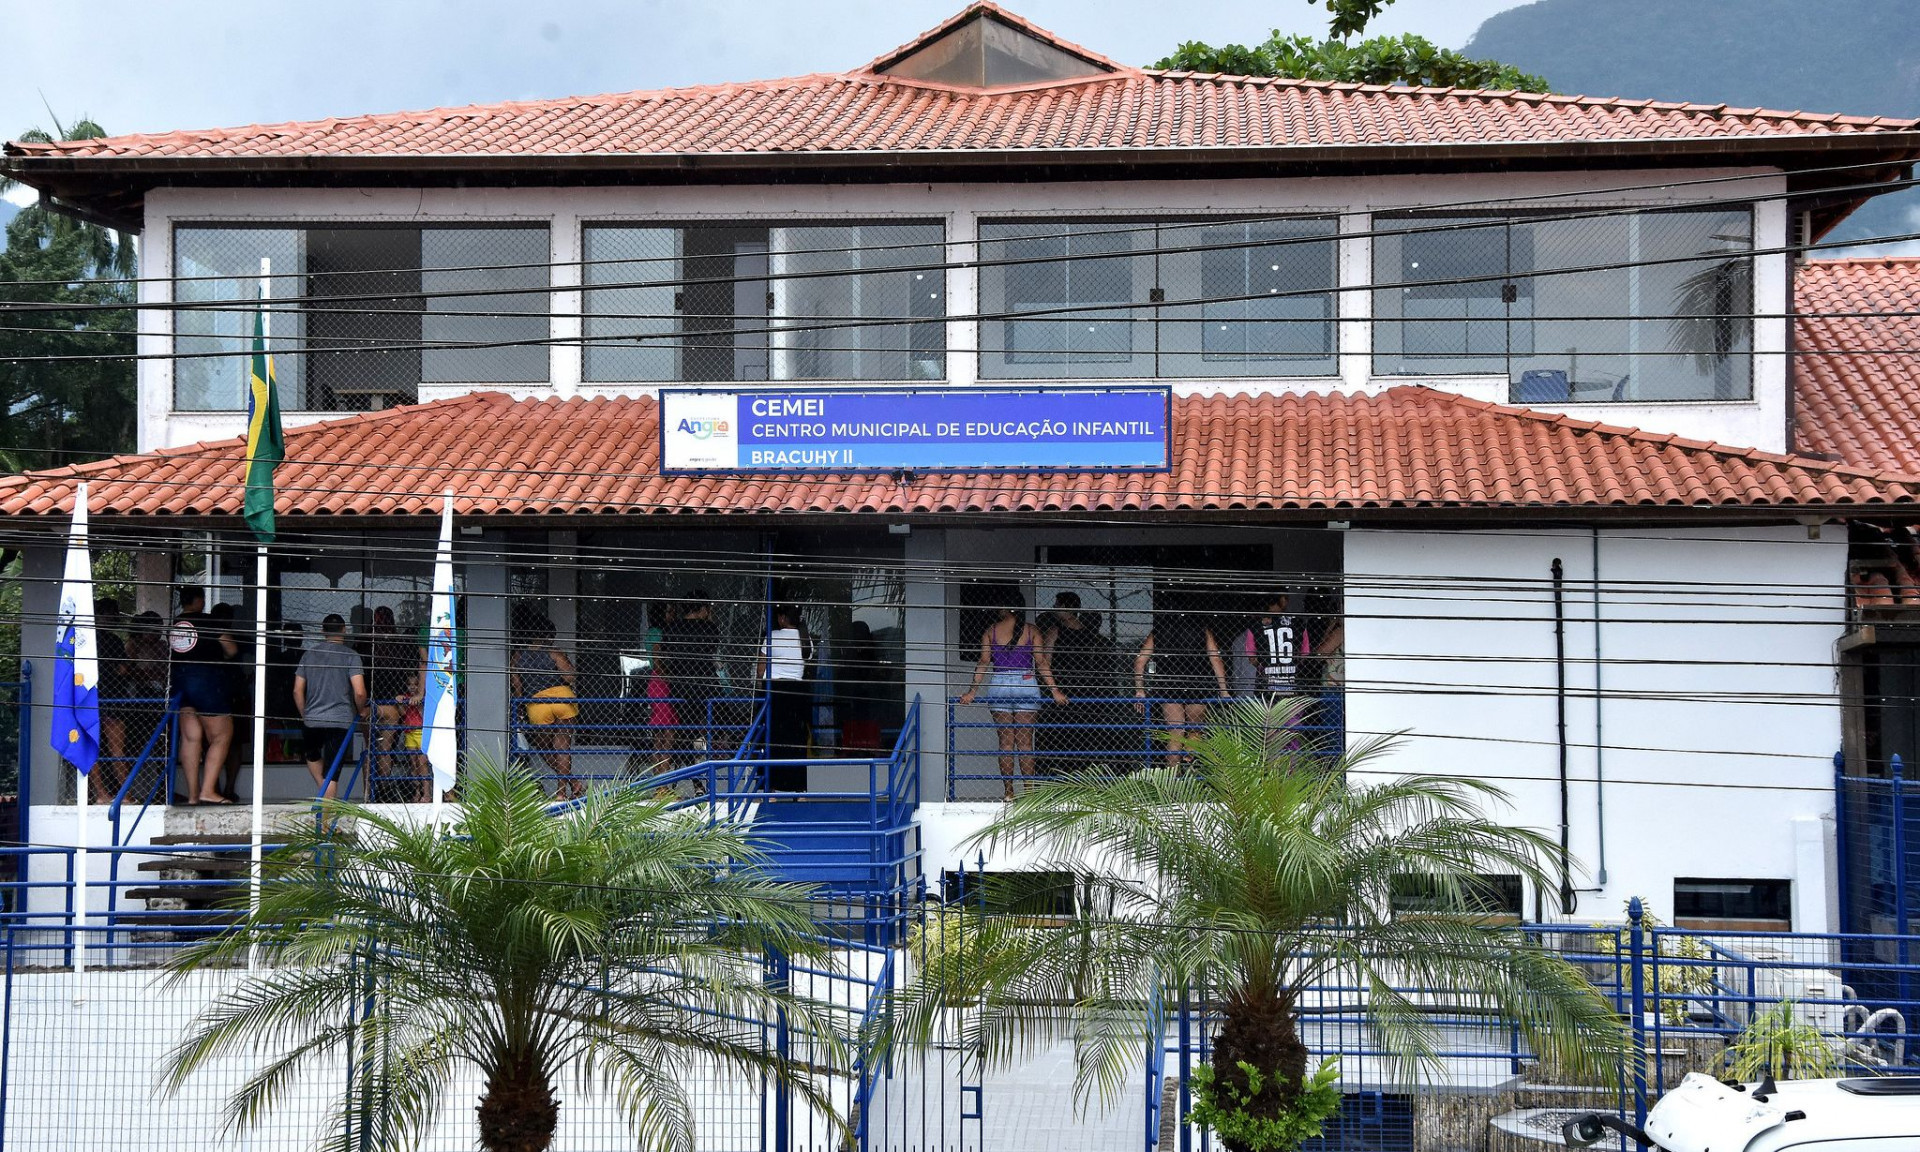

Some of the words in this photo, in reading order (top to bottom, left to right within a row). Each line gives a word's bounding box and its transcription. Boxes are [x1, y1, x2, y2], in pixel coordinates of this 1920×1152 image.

[751, 399, 824, 417] CEMEI
[677, 418, 729, 440] Angra
[752, 423, 826, 438] CENTRO
[831, 422, 932, 437] MUNICIPAL
[936, 422, 961, 437] DE
[966, 419, 1067, 439] EDUCAÇÃO
[1073, 421, 1155, 436] INFANTIL
[751, 450, 839, 464] BRACUHY
[843, 449, 853, 464] II
[1263, 627, 1293, 664] 16
